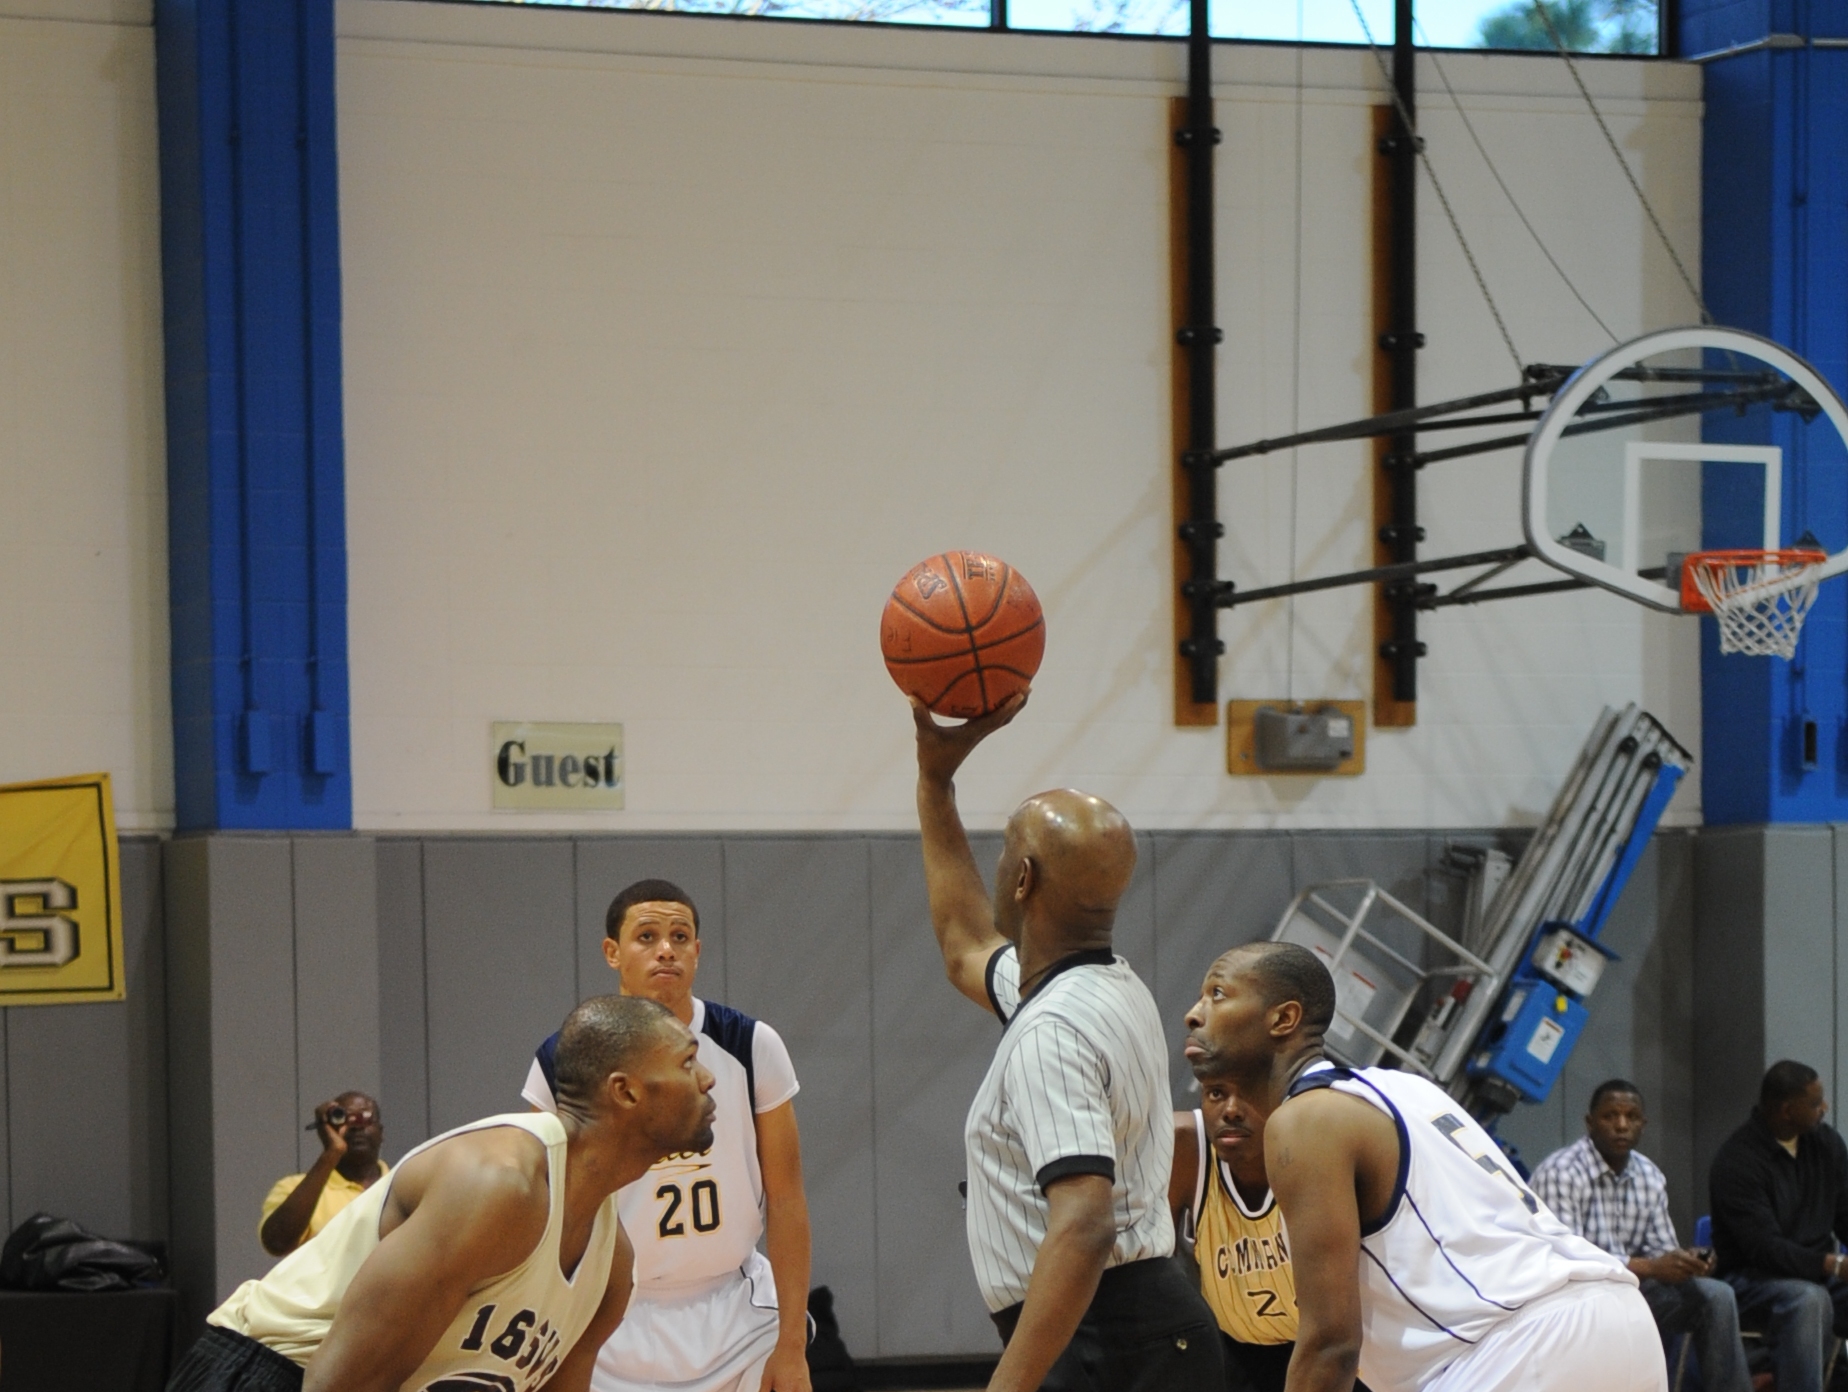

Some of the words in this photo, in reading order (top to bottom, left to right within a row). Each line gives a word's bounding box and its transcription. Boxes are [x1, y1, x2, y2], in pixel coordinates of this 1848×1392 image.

[497, 739, 620, 788] Guest
[0, 877, 80, 969] S
[655, 1177, 722, 1240] 20
